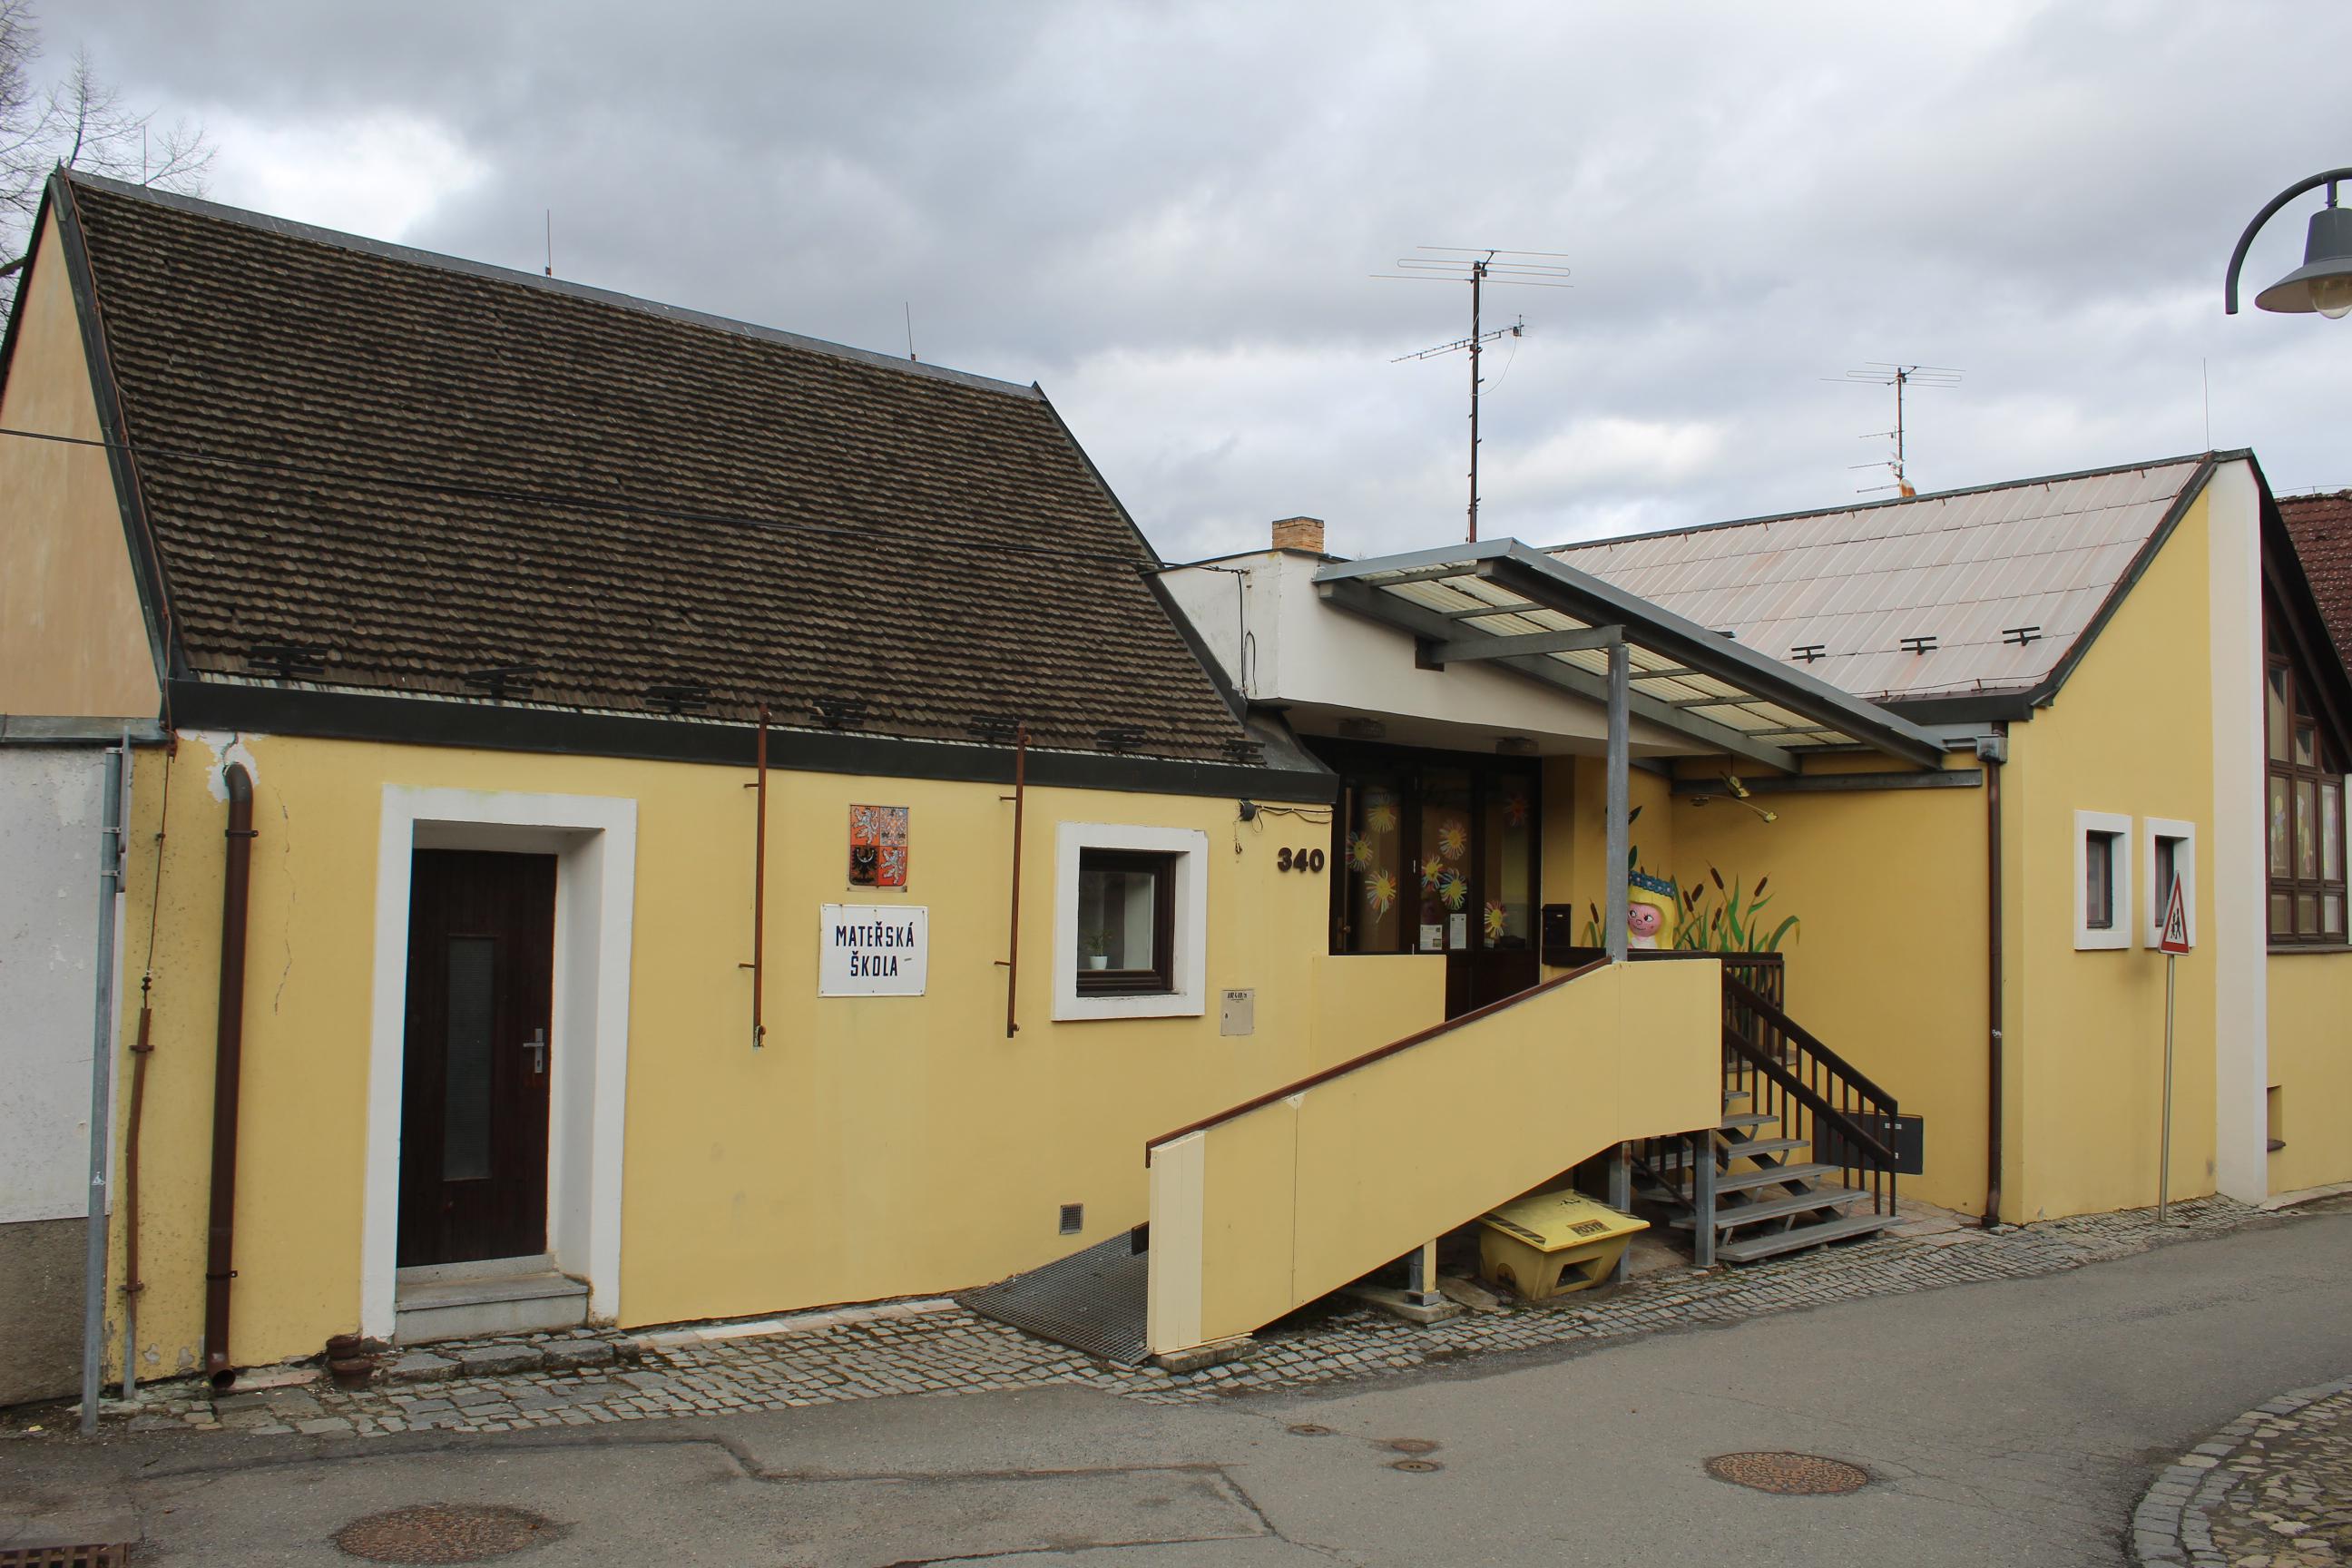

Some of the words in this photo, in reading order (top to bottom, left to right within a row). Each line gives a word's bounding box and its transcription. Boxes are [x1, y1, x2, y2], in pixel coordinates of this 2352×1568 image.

[1277, 847, 1325, 873] 340
[836, 921, 915, 947] MATEŘSKÁ
[850, 950, 897, 976] ŠKOLA
